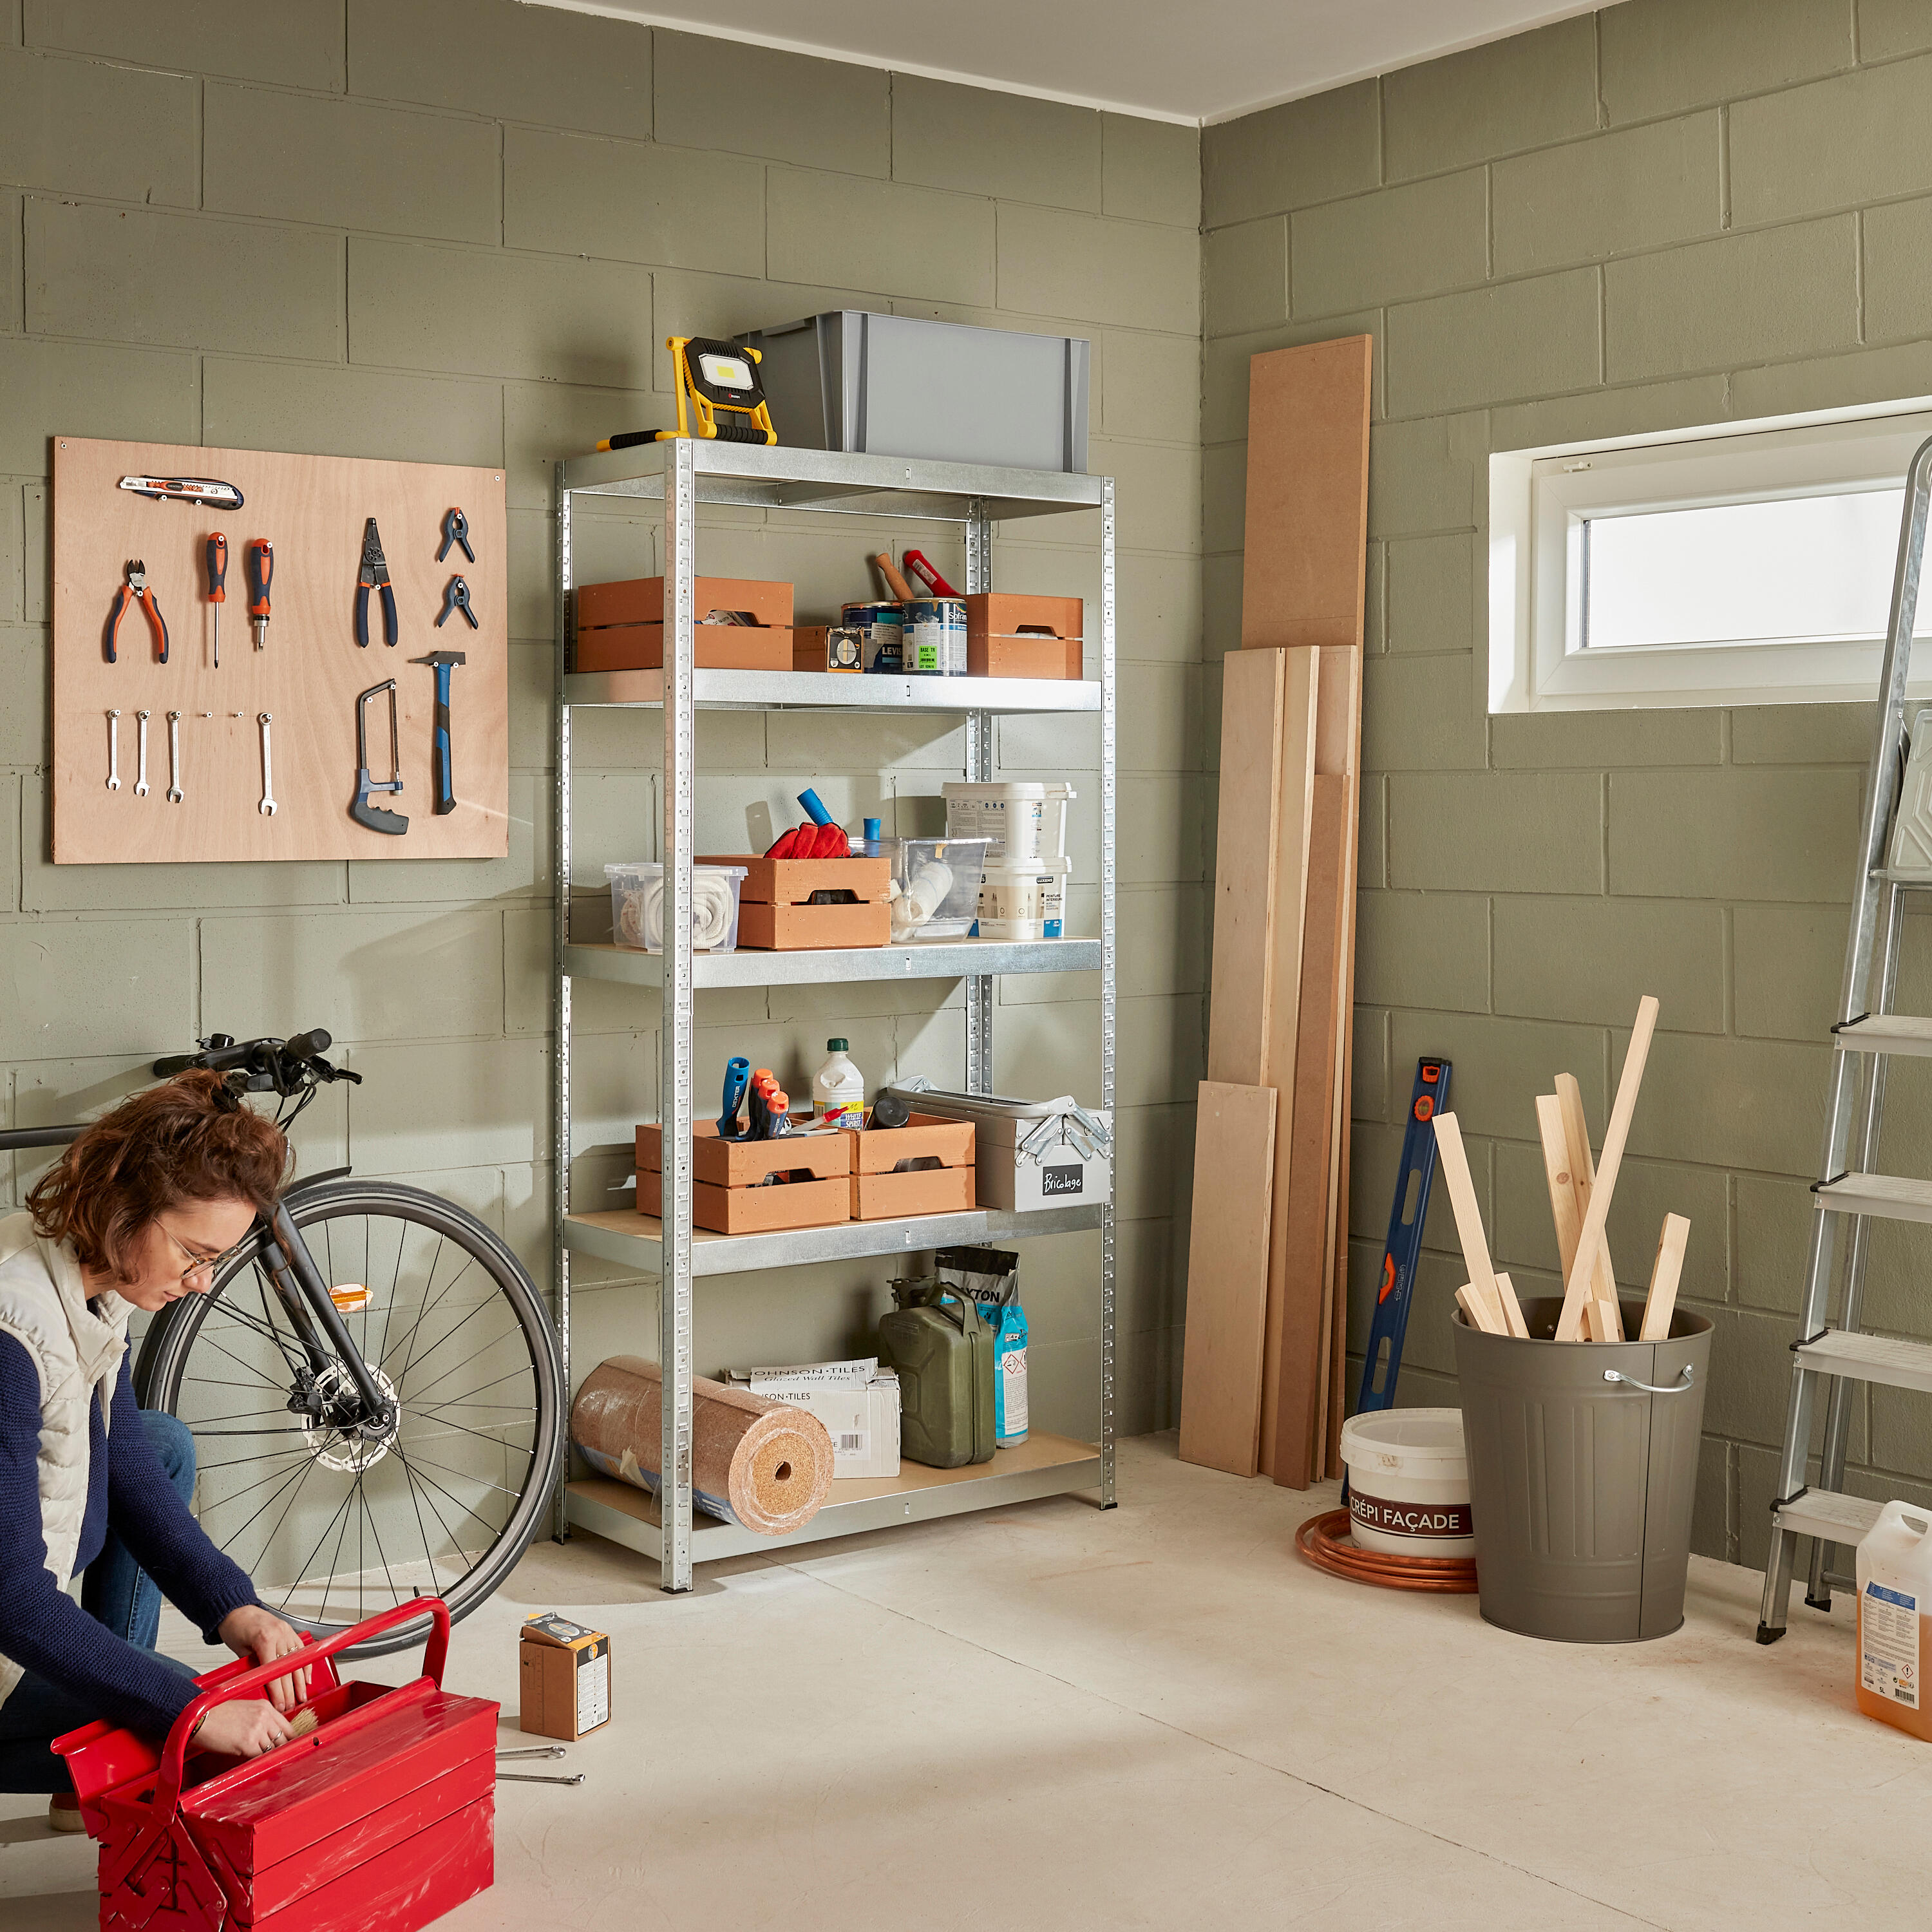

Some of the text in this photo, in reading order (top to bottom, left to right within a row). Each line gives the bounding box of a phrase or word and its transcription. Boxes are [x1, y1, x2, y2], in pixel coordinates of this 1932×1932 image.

[882, 647, 902, 655] LEVIS
[732, 1086, 741, 1108] DEXTER
[1044, 1173, 1081, 1193] Bricolage
[1350, 1496, 1459, 1532] CRÉPI FAÇADE
